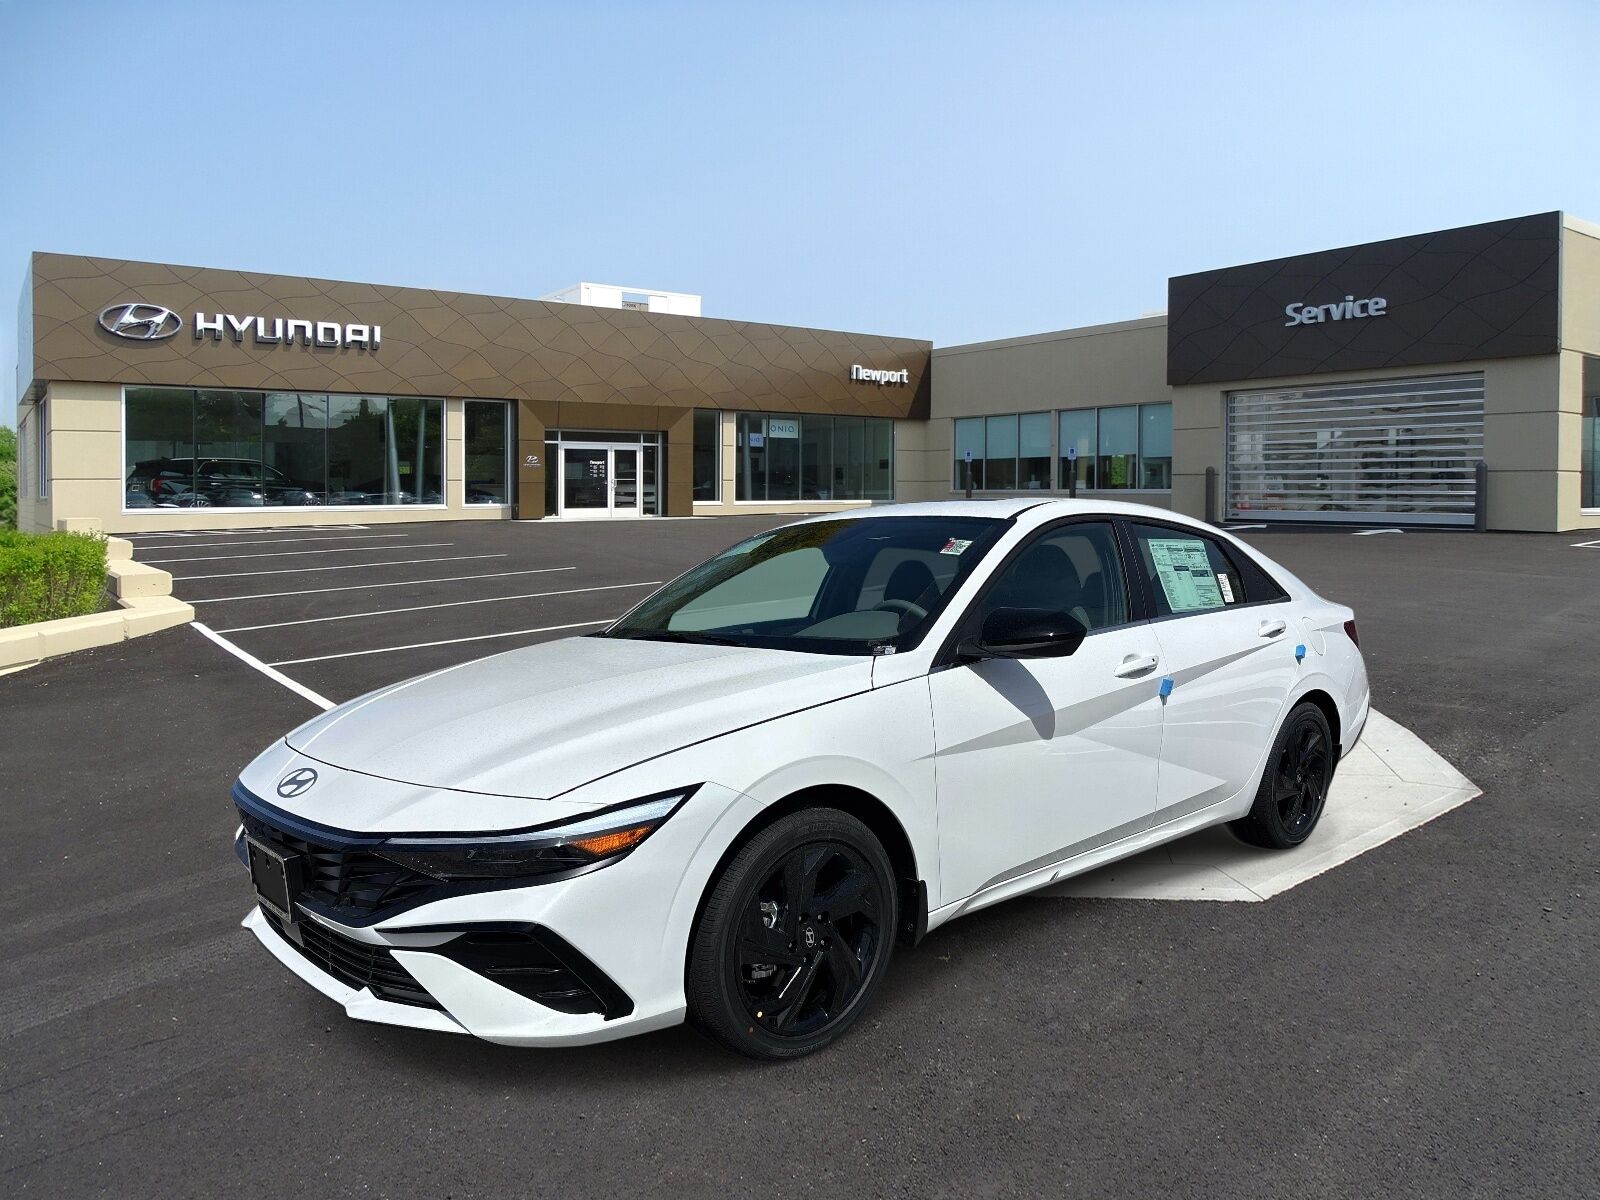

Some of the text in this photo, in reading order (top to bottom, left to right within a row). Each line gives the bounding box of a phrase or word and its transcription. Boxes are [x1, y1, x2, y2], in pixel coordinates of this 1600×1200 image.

[1284, 295, 1388, 327] Service
[194, 312, 382, 350] HYUNDAI
[850, 364, 909, 385] Newport
